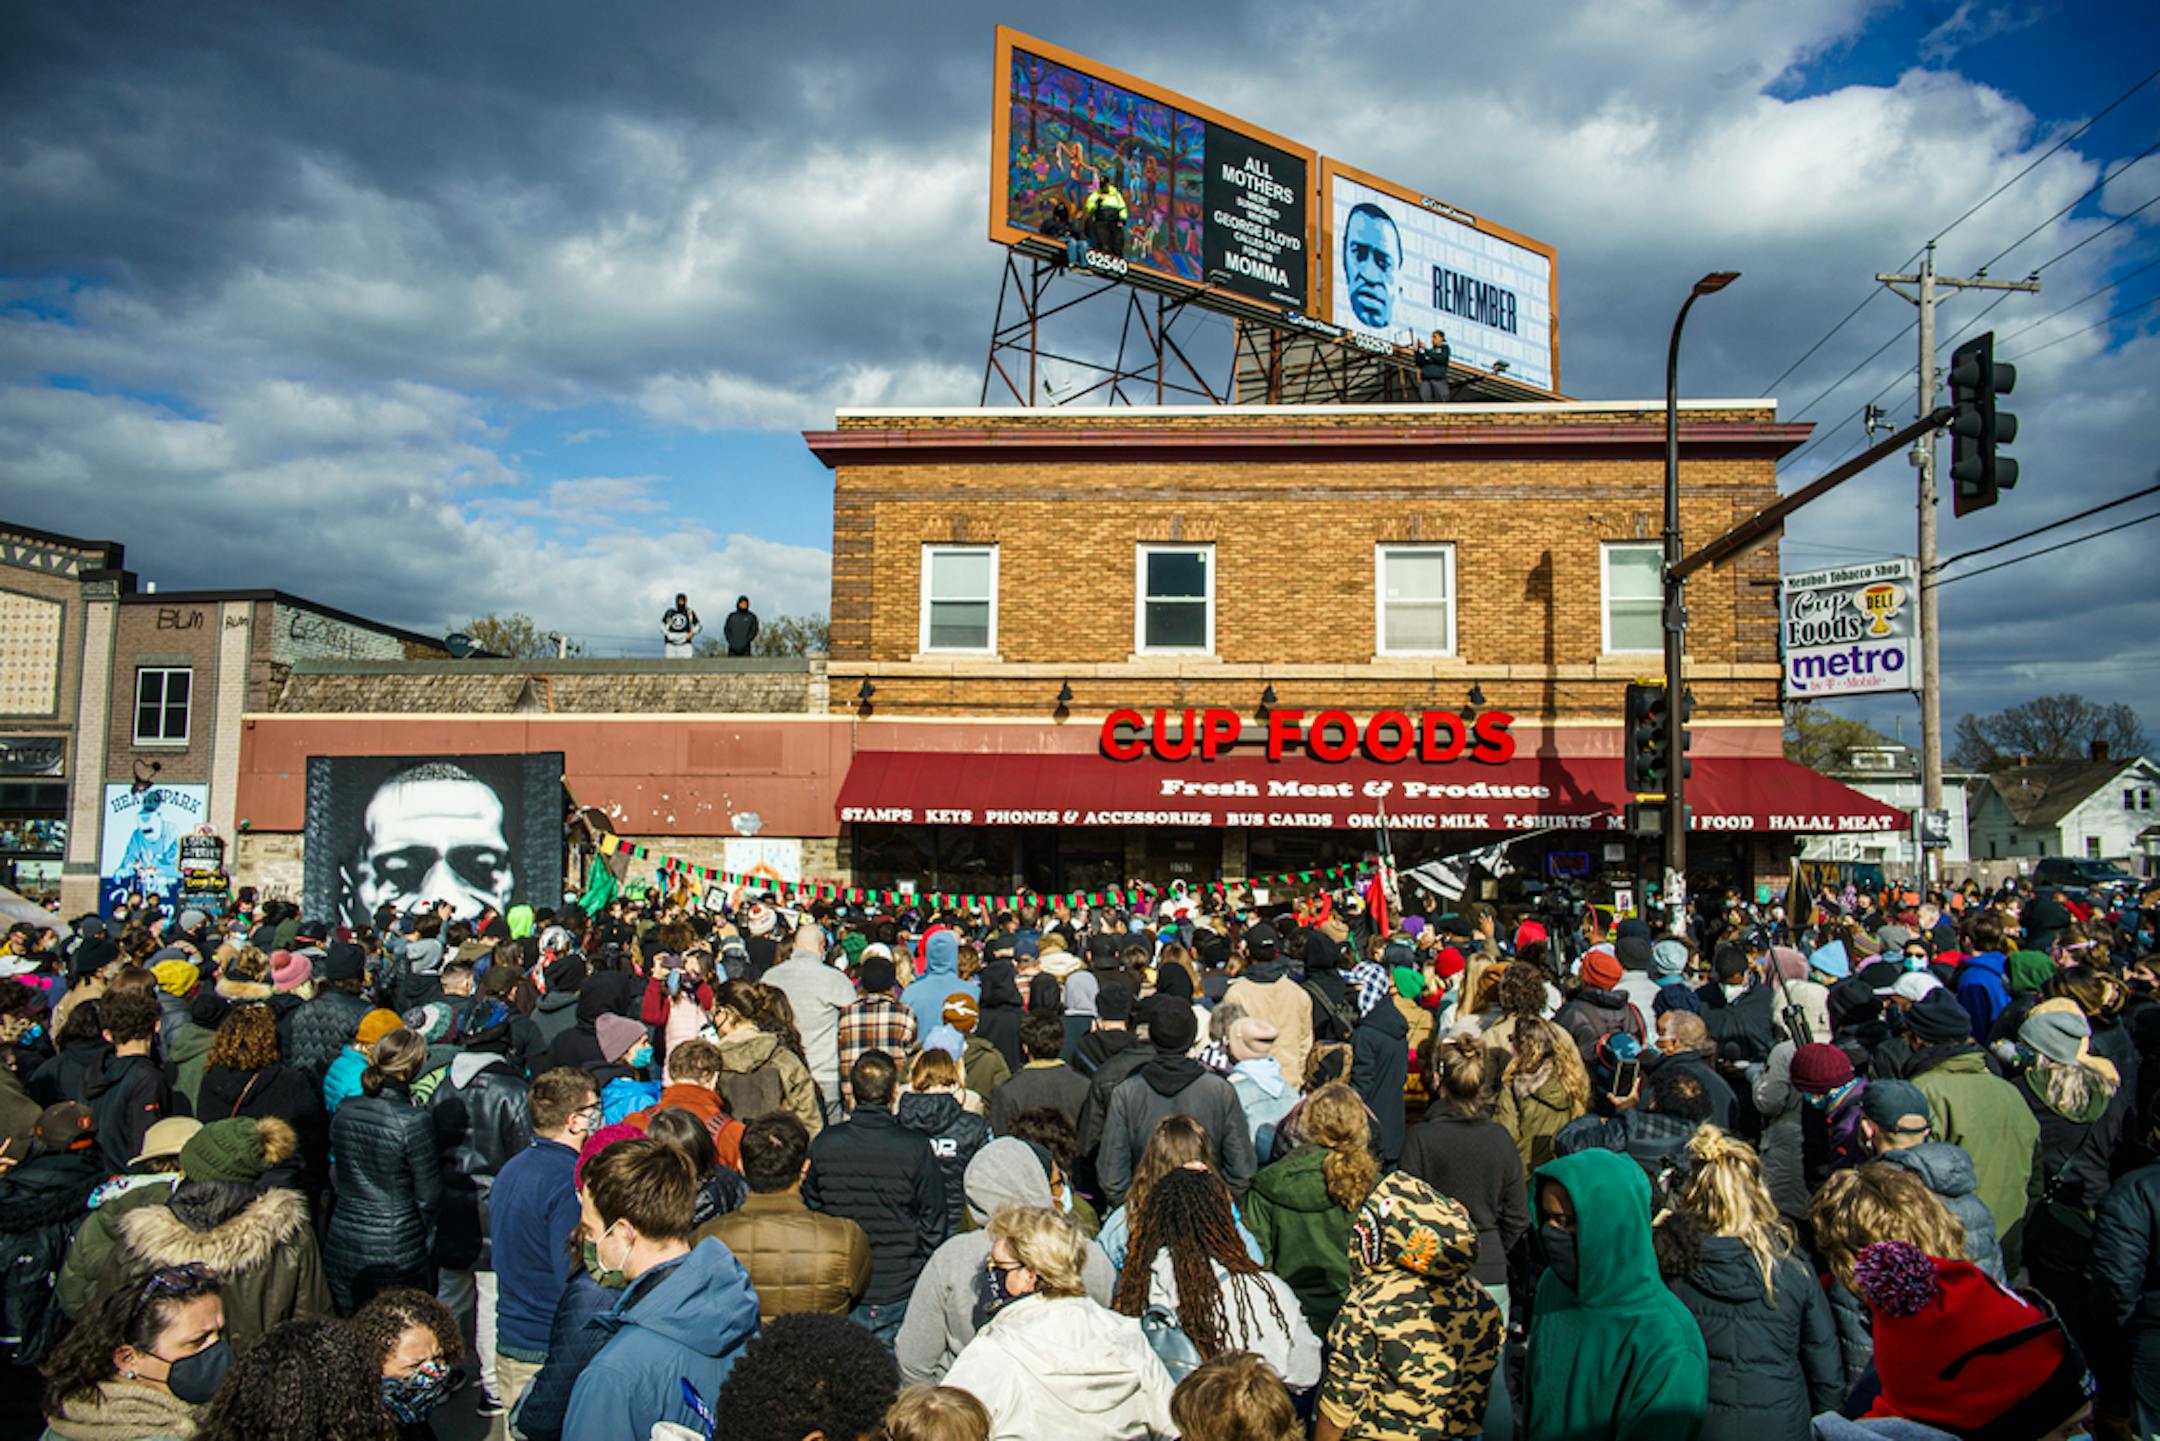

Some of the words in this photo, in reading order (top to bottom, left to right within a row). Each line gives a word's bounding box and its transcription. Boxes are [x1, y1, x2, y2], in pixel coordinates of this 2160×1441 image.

[1244, 157, 1273, 180] ALL
[1222, 164, 1294, 204] MOTHERS
[1213, 210, 1263, 238] GEORGE
[1264, 227, 1301, 250] FLOYD
[1224, 250, 1290, 289] MOMMA
[1432, 264, 1517, 336] REMEMBER
[1830, 568, 1872, 583] Tobacco
[1875, 563, 1901, 576] Shop
[1793, 591, 1854, 620] Cup
[1866, 592, 1894, 609] DELI
[157, 608, 204, 630] BLM
[1788, 616, 1861, 645] Foods
[1793, 645, 1904, 679] metro
[1100, 708, 1242, 760] CUP
[1268, 710, 1516, 762] FOODS
[1160, 779, 1259, 797] Fresh
[1267, 780, 1353, 797] Meat
[1362, 780, 1394, 798] &
[1402, 781, 1550, 799] Produce
[841, 808, 913, 823] STAMPS
[925, 809, 973, 823] KEYS
[985, 809, 1060, 824] PHONES
[1063, 810, 1080, 825] &
[1083, 811, 1213, 826] ACCESSORIES
[1226, 812, 1265, 827] BUS
[1268, 813, 1333, 828] CARDS
[1347, 813, 1437, 829] ORGANIC
[1439, 814, 1490, 829] MILK
[1503, 814, 1593, 830] T-SHIRTS
[1701, 815, 1755, 831] FOOD
[1768, 815, 1834, 831] HALAL
[1837, 815, 1893, 830] MEAT
